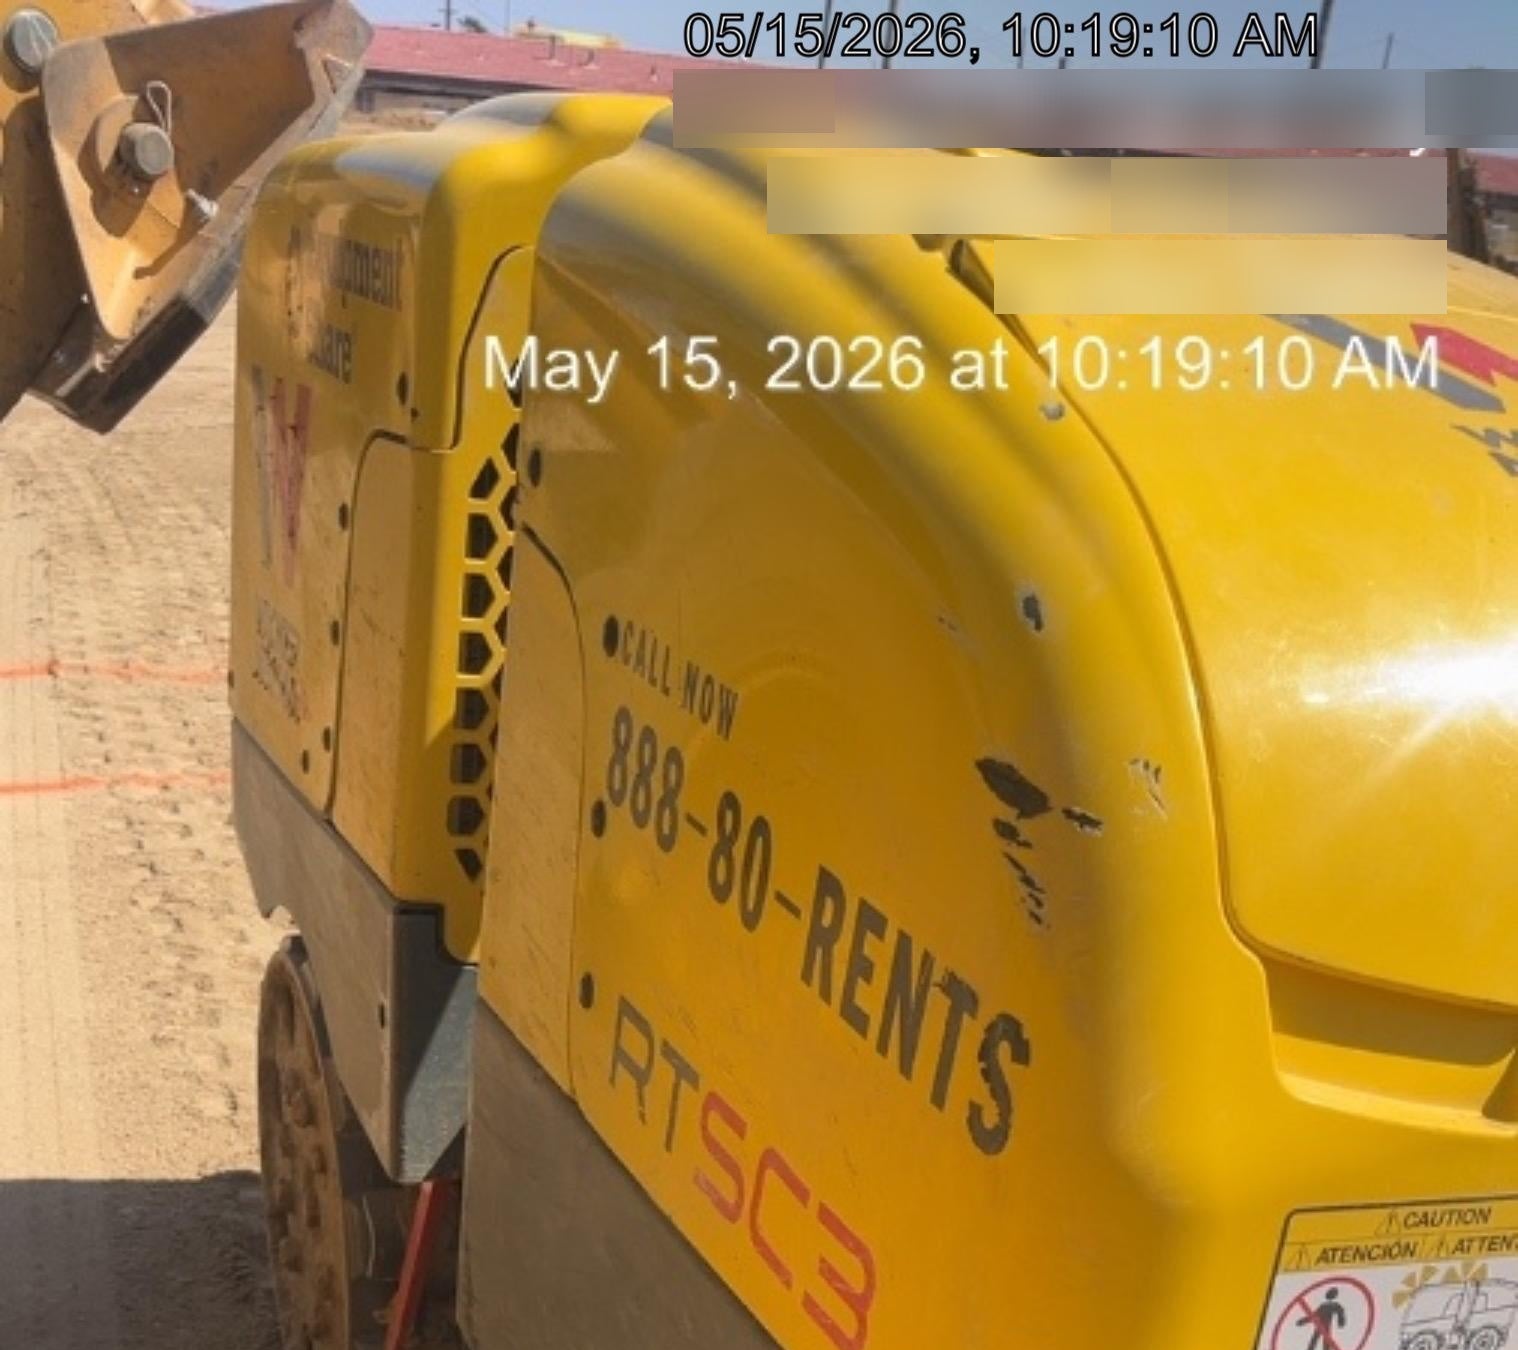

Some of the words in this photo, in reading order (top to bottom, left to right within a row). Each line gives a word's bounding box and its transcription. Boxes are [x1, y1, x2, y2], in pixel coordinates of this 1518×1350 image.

[621, 620, 671, 697] CALL
[680, 661, 740, 741] NOW
[604, 704, 1031, 1157] 888-80-RENTS
[1314, 1240, 1419, 1265] ATENCIÓN
[1402, 1207, 1493, 1231] CAUTION
